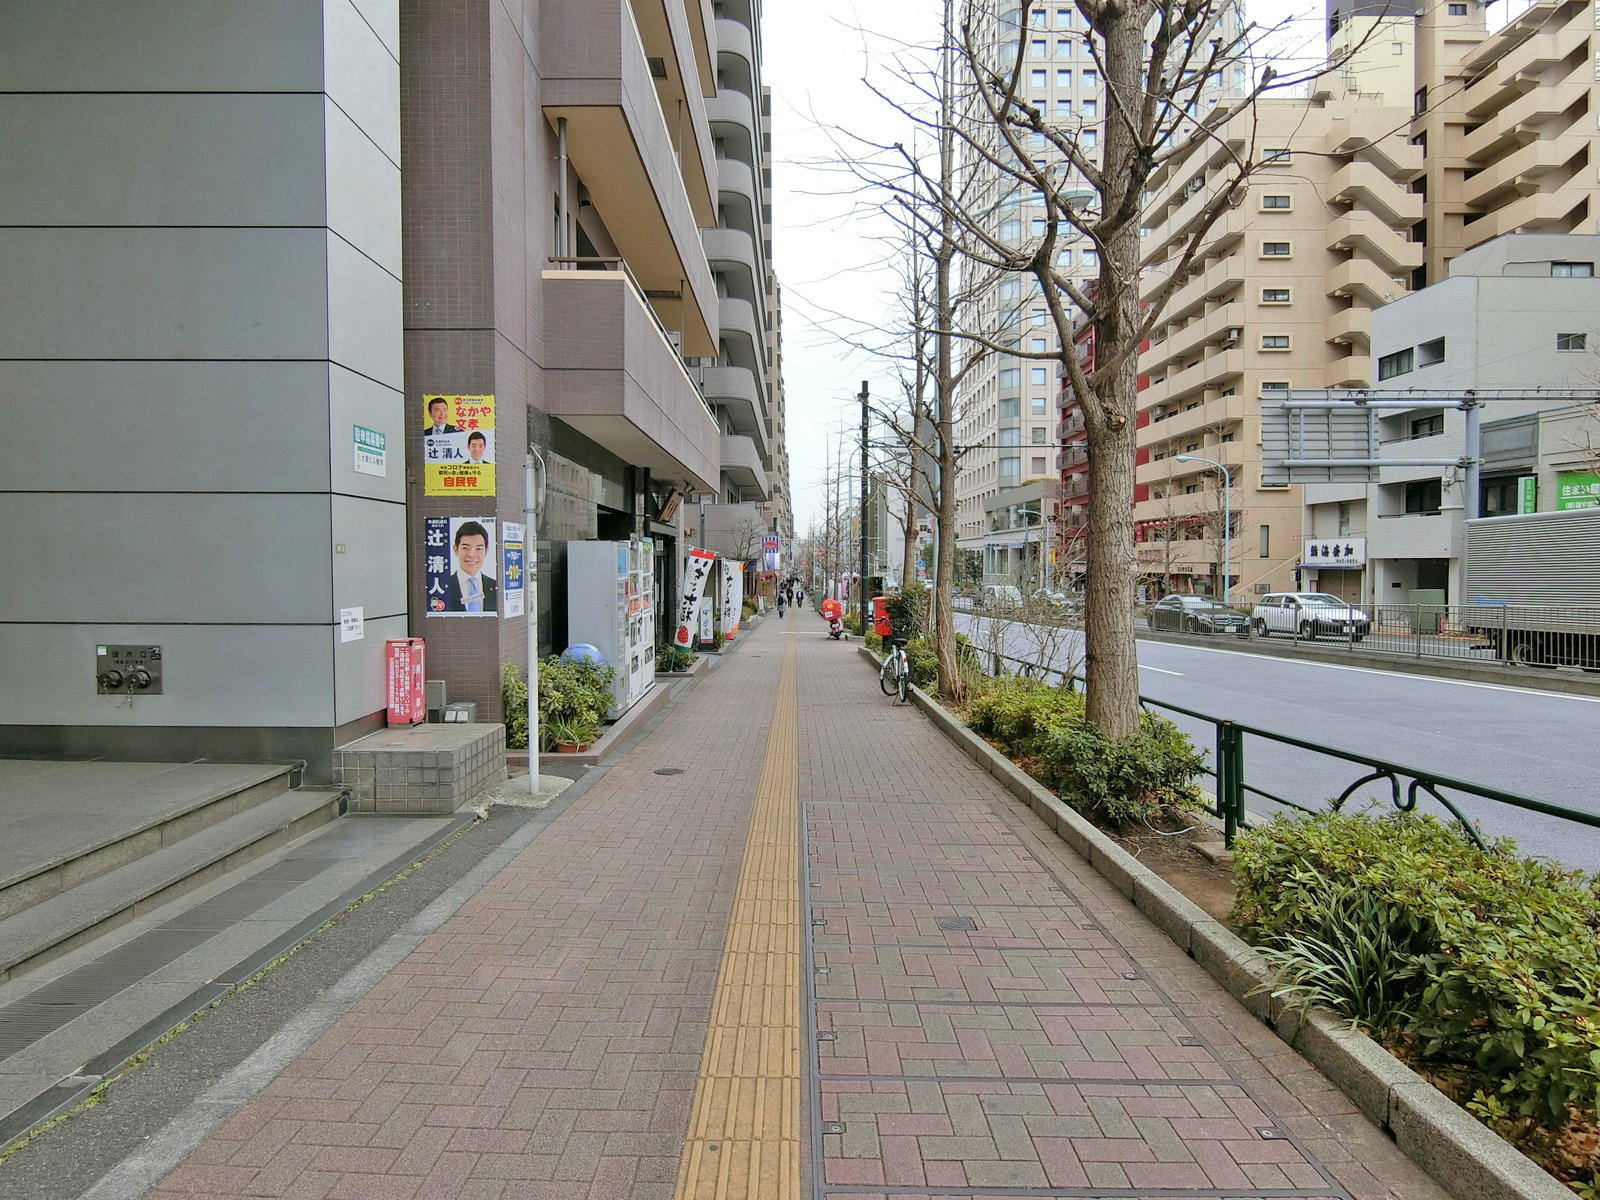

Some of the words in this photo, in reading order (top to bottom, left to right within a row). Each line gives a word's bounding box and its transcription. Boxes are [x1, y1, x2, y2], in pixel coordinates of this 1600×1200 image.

[456, 406, 491, 417] なかや
[456, 419, 479, 430] 文孝
[428, 448, 438, 458] 辻
[442, 448, 463, 459] 清人
[444, 477, 477, 487] 自民党
[428, 529, 444, 546] 辻
[428, 555, 445, 595] 清人
